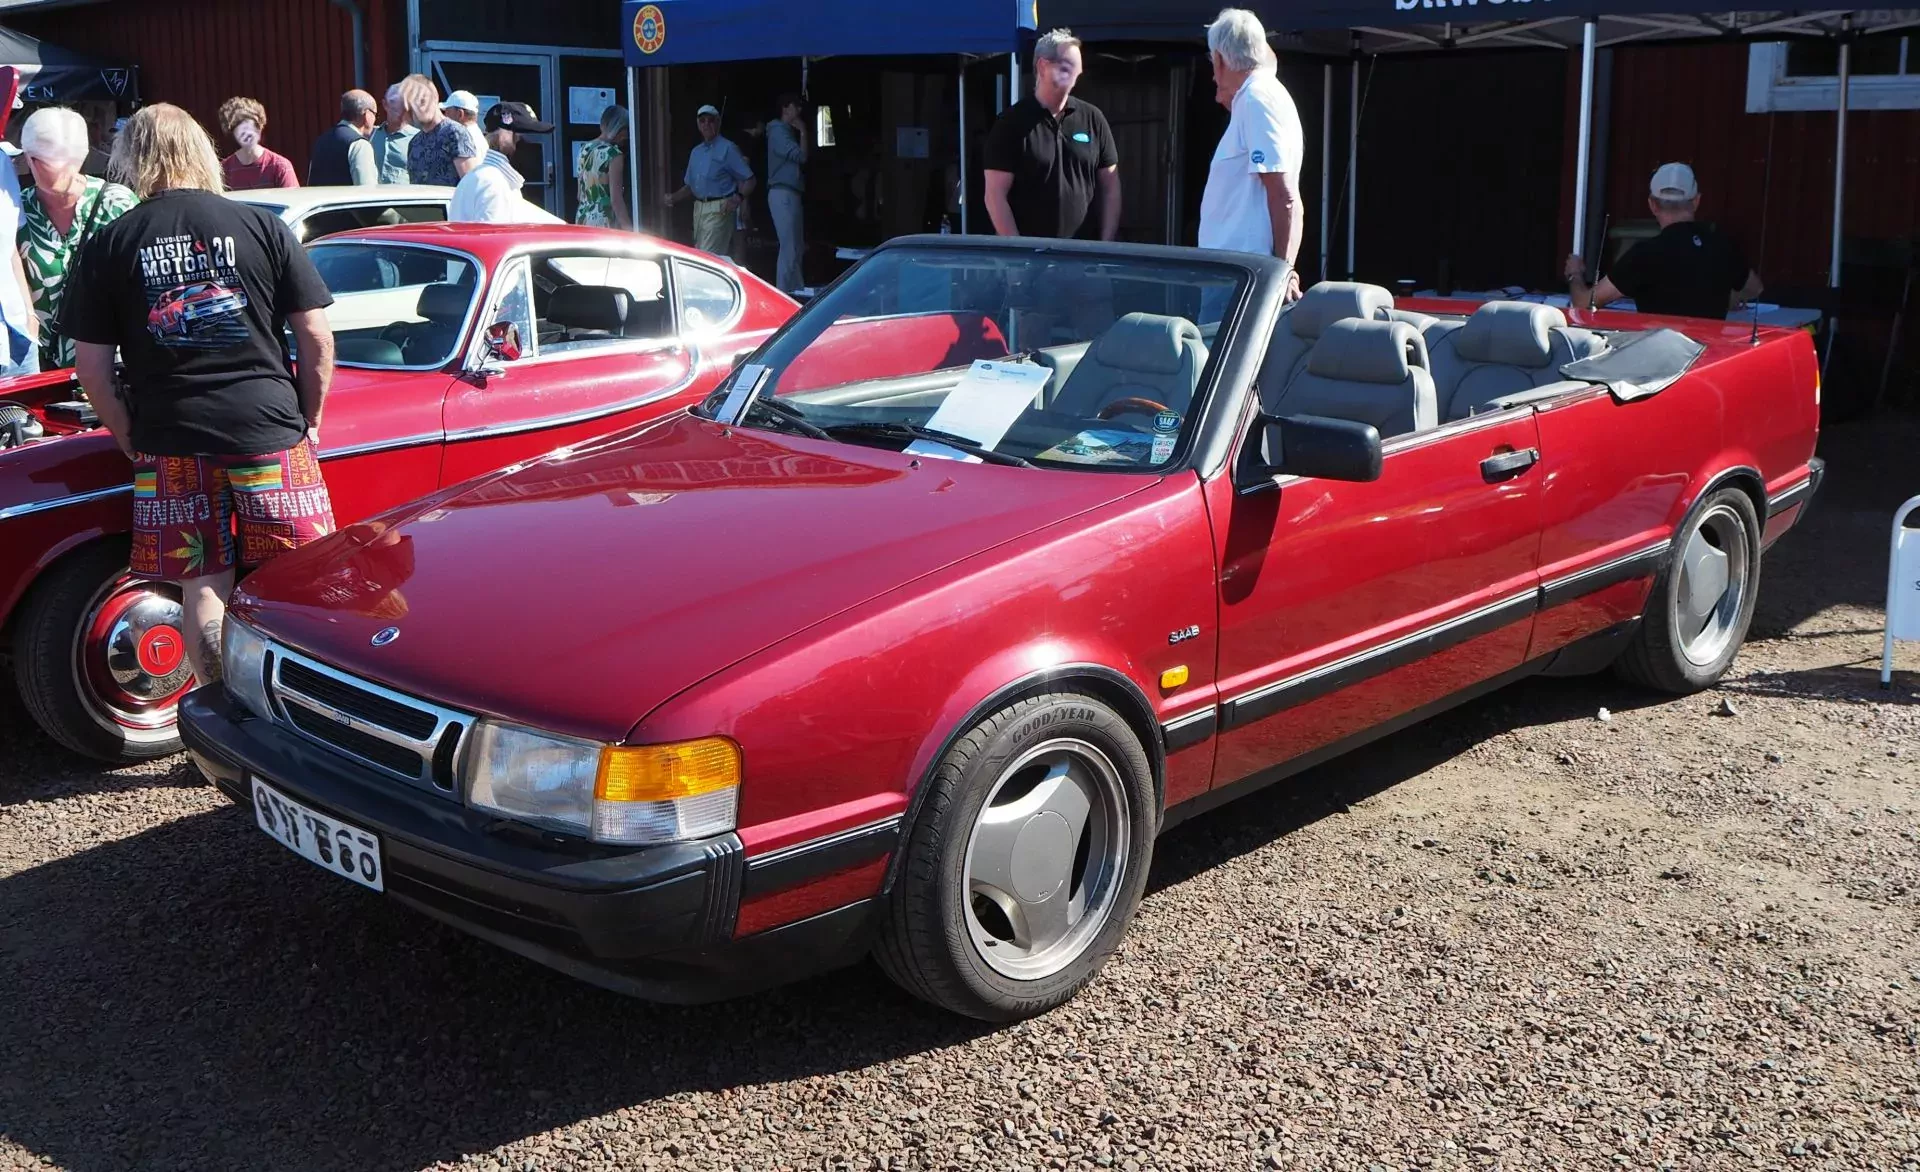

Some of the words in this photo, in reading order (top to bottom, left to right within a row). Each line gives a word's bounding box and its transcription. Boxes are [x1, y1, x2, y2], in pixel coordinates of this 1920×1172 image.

[139, 242, 194, 262] MUSIK
[212, 236, 236, 267] 20
[142, 254, 209, 278] MOTOR
[1168, 624, 1200, 645] SAAB
